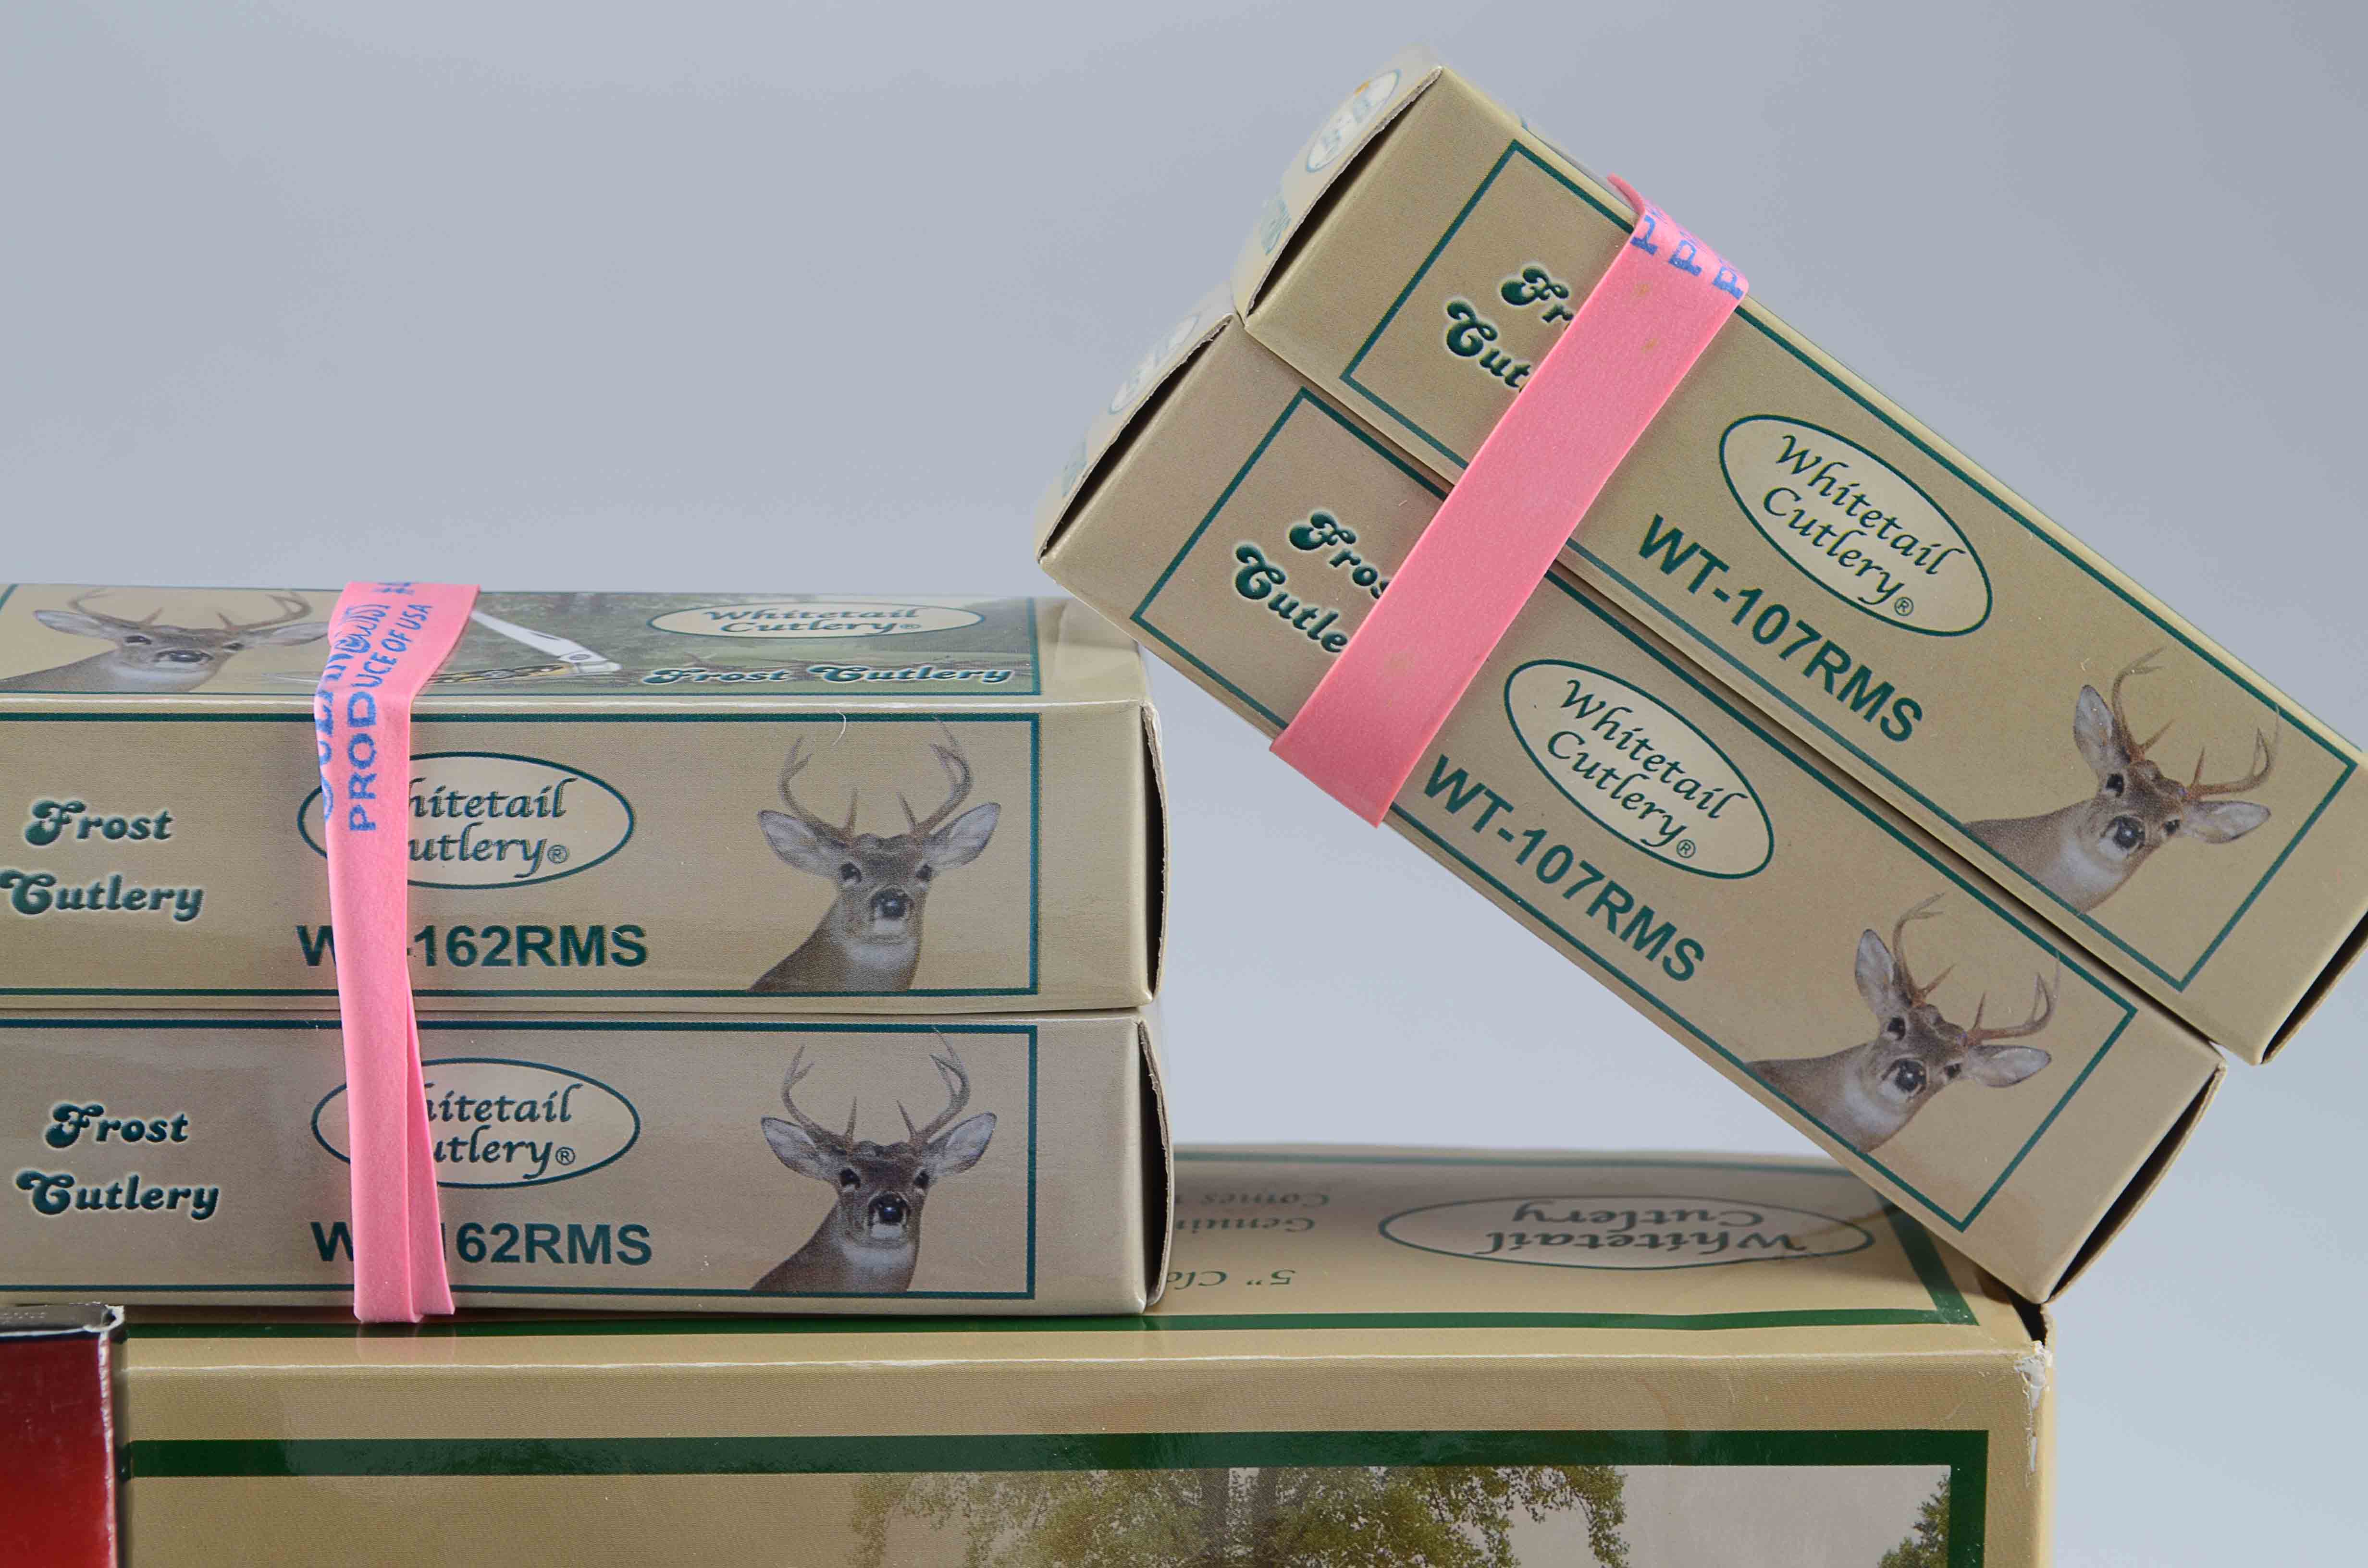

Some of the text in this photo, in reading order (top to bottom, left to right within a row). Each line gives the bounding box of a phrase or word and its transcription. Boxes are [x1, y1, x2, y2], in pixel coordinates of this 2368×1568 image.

[1775, 434, 1966, 576] Whitetail
[395, 603, 434, 630] USA
[706, 608, 919, 621] Whitetail
[1235, 545, 1347, 653] Cutle
[381, 629, 413, 652] OF
[1639, 514, 1923, 742] WT-107RMS
[642, 664, 1012, 685] Frost Cutlery
[347, 652, 397, 832] PRODUCE
[1560, 680, 1748, 820] Whitetail
[409, 777, 578, 818] hitetail
[25, 799, 173, 846] Frost
[1423, 754, 1705, 982] WT-107RMS
[0, 869, 204, 922] Cutlery
[45, 1103, 189, 1148] Frost
[16, 1171, 219, 1221] Cutlery
[1512, 1201, 1764, 1233] Cutlery
[1475, 1231, 1807, 1255] Whitetail
